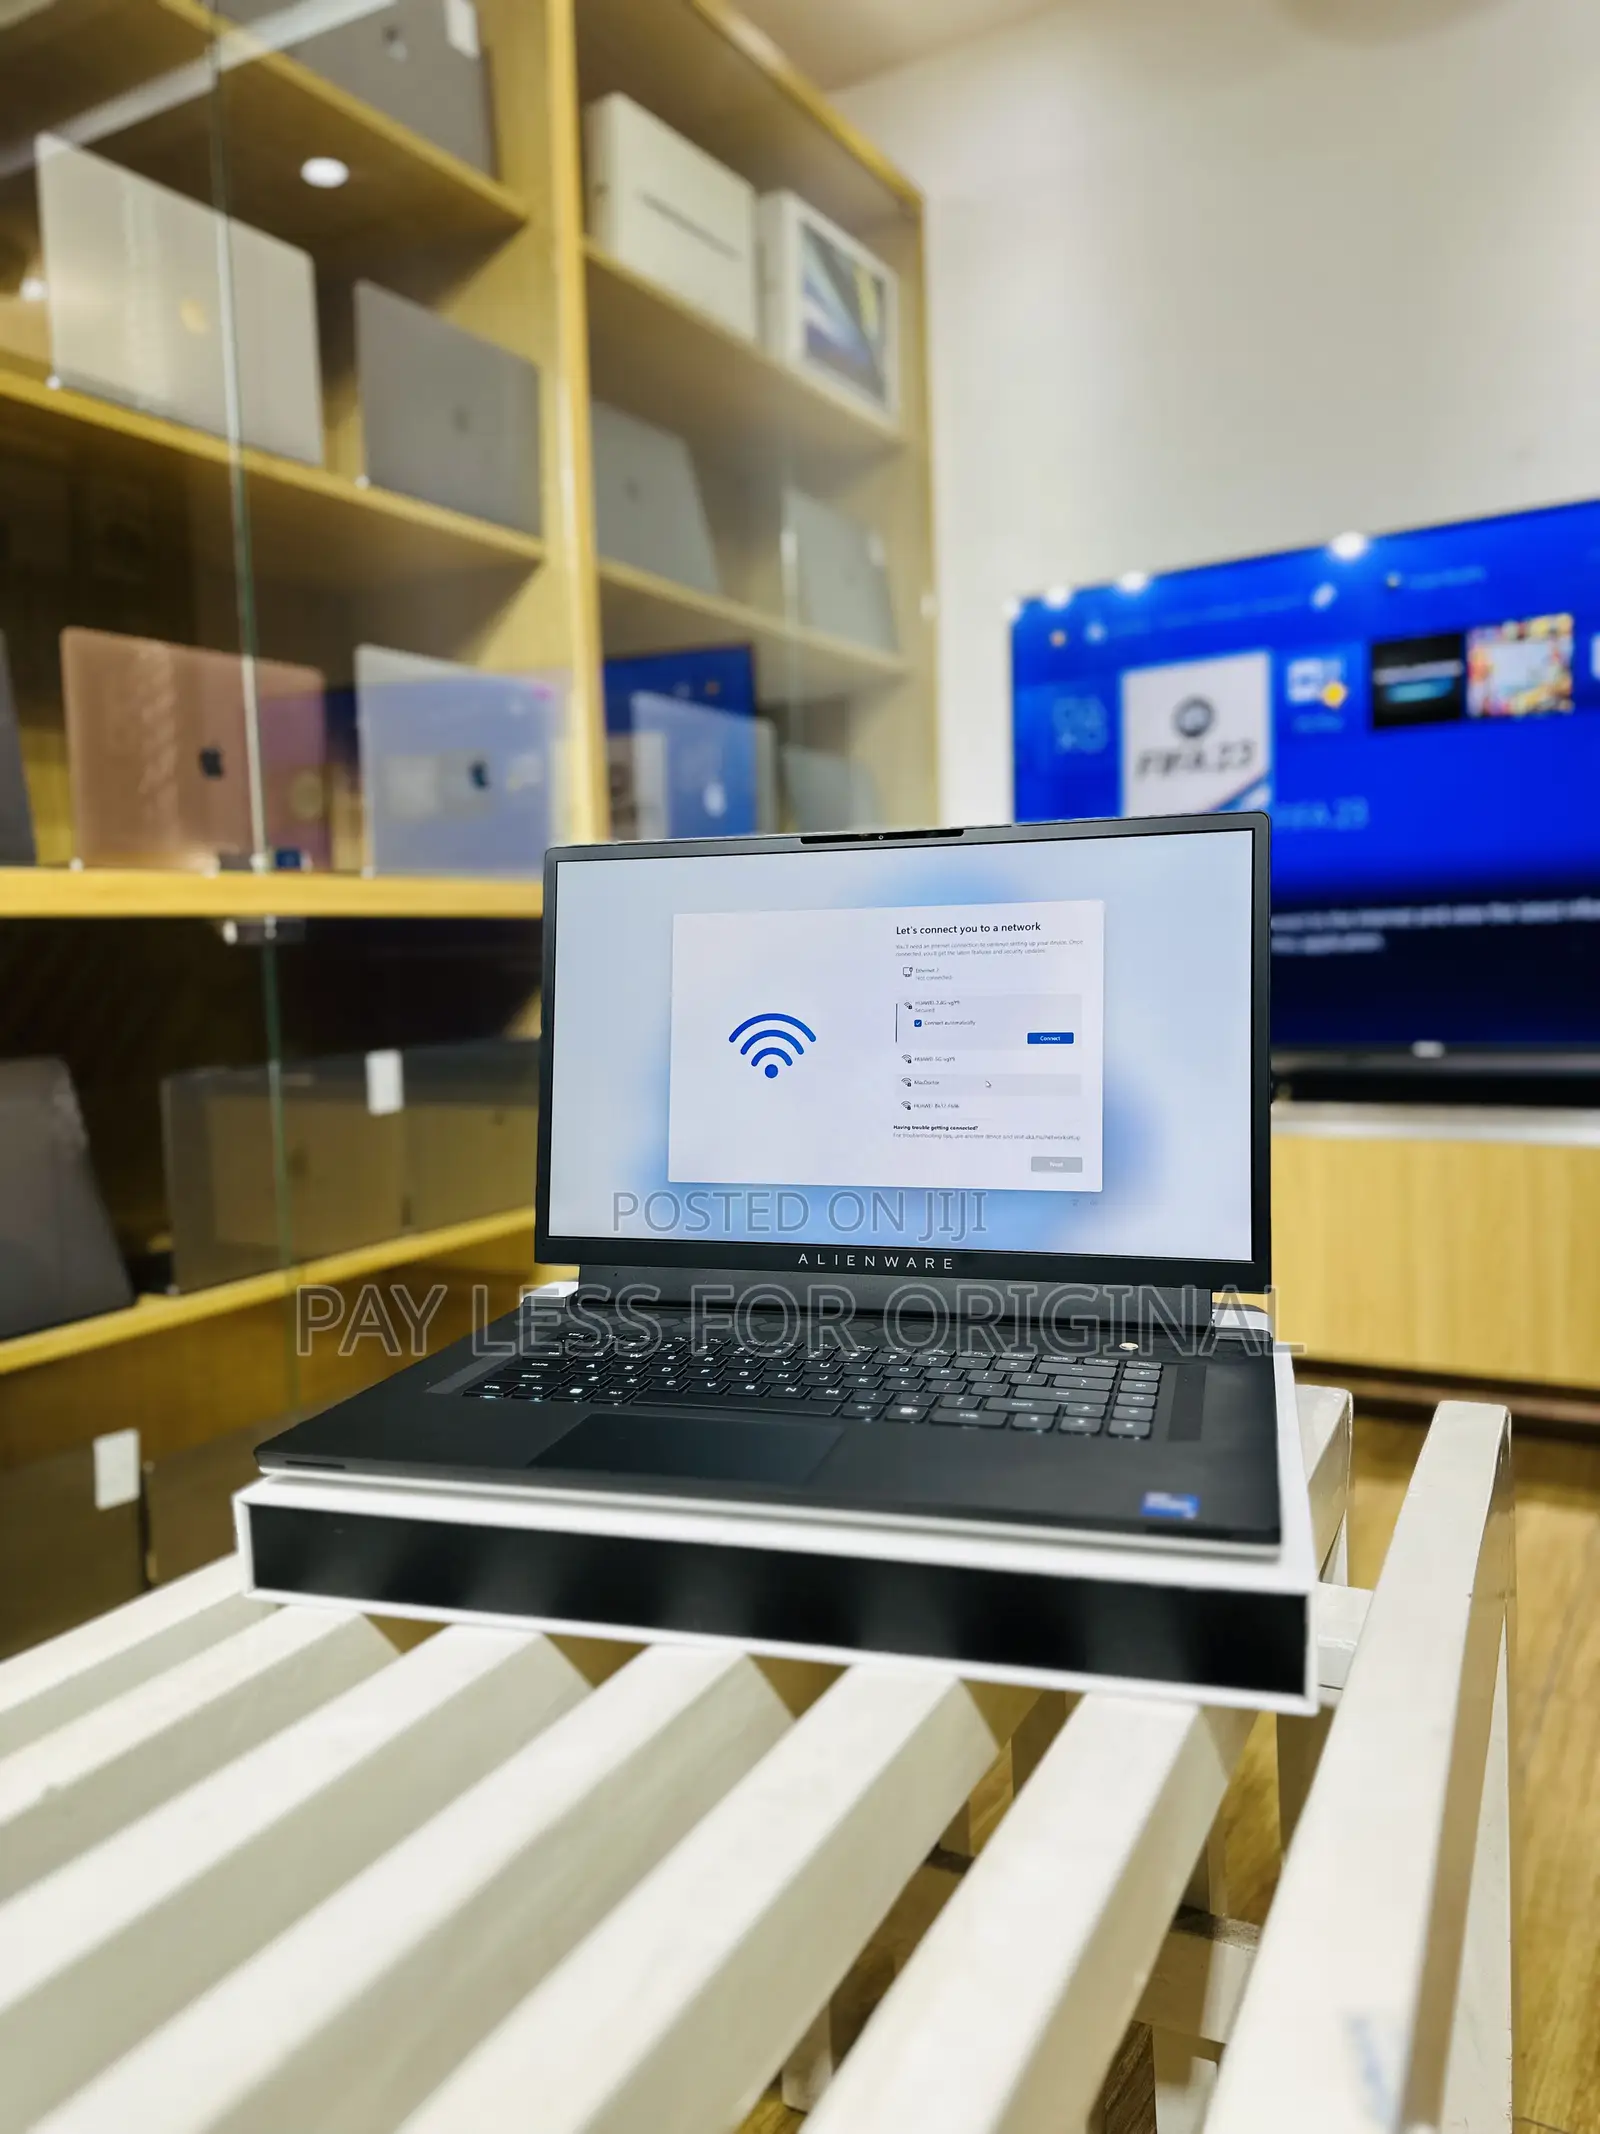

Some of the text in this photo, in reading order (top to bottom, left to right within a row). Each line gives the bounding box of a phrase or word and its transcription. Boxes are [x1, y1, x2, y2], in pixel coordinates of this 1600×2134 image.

[896, 926, 918, 935] Let's
[920, 925, 958, 935] connect
[960, 926, 978, 936] you
[980, 925, 991, 933] to
[1001, 921, 1042, 932] network
[1039, 1034, 1062, 1042] Connect
[797, 1253, 955, 1270] ALIENWARE
